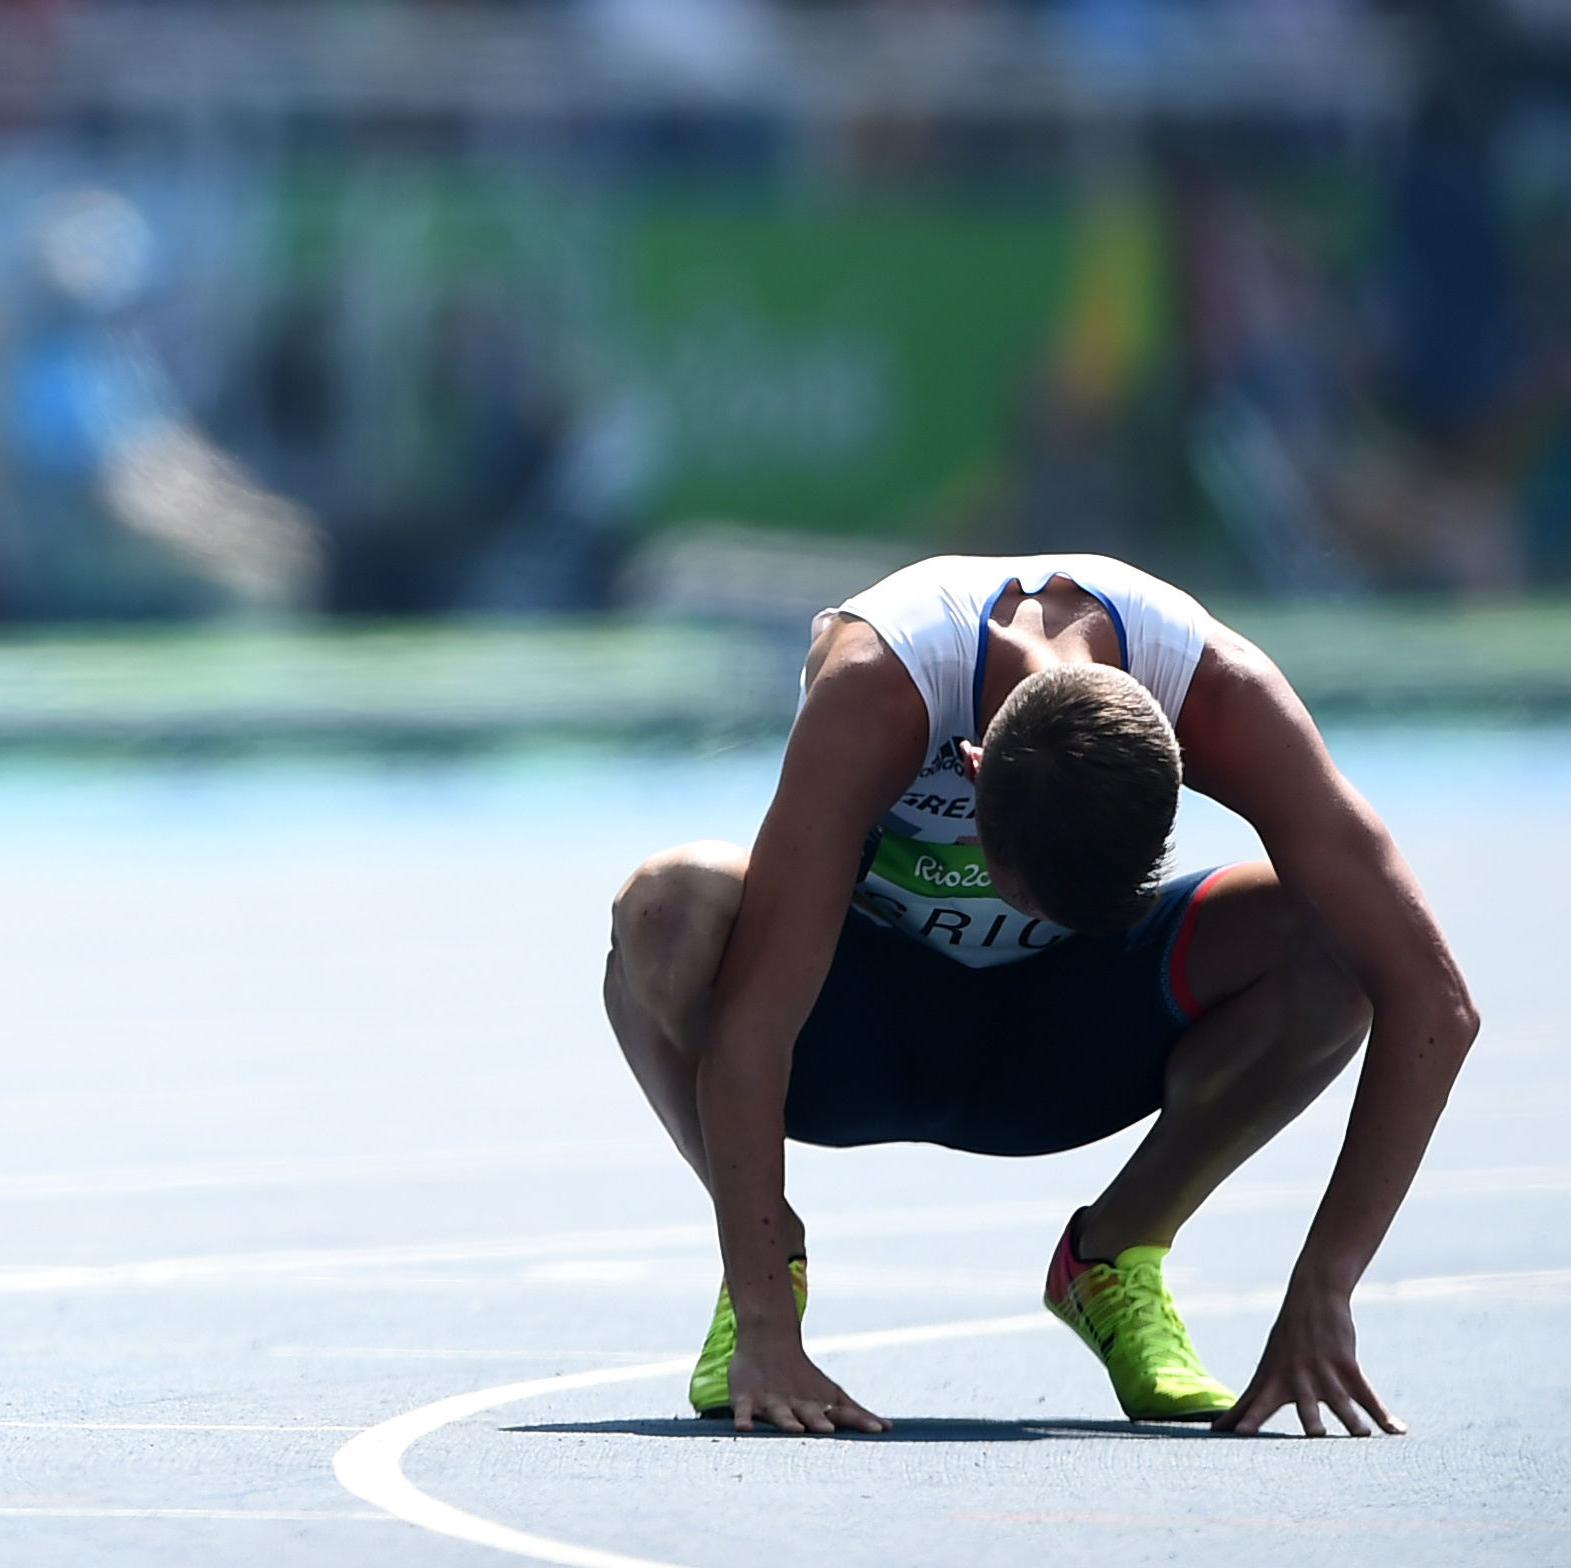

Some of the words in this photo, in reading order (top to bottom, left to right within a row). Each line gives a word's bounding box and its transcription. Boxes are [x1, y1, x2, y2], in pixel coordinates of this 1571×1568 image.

[919, 756, 966, 778] adida
[902, 792, 976, 819] GRE
[914, 854, 993, 889] Rio20
